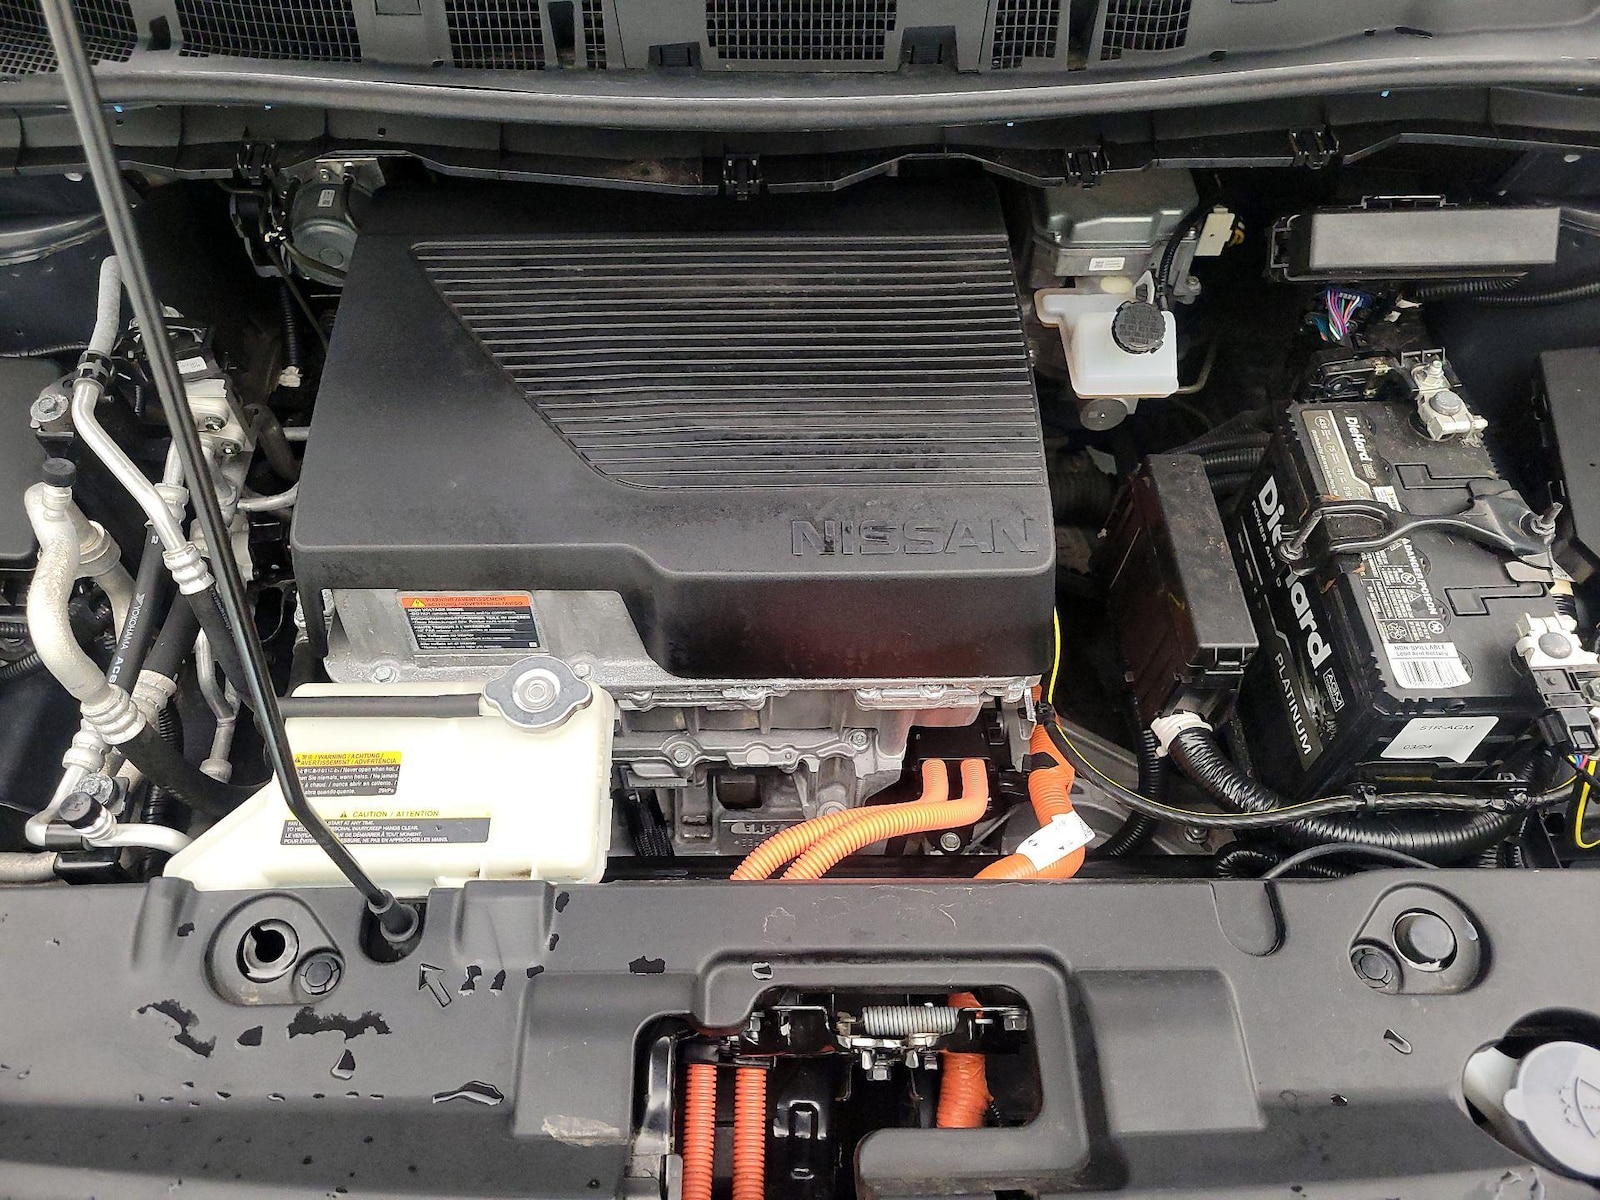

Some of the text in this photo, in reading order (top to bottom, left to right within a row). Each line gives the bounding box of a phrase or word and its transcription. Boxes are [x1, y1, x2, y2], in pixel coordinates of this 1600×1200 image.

[1345, 416, 1373, 463] DieHard
[790, 518, 1038, 556] NISSAN
[1252, 499, 1282, 587] POWER AHED
[1405, 544, 1438, 615] DANGER/POISON
[120, 605, 143, 650] YOKOHAMA
[1274, 652, 1312, 755] PLATINUM
[1327, 672, 1344, 706] AGM
